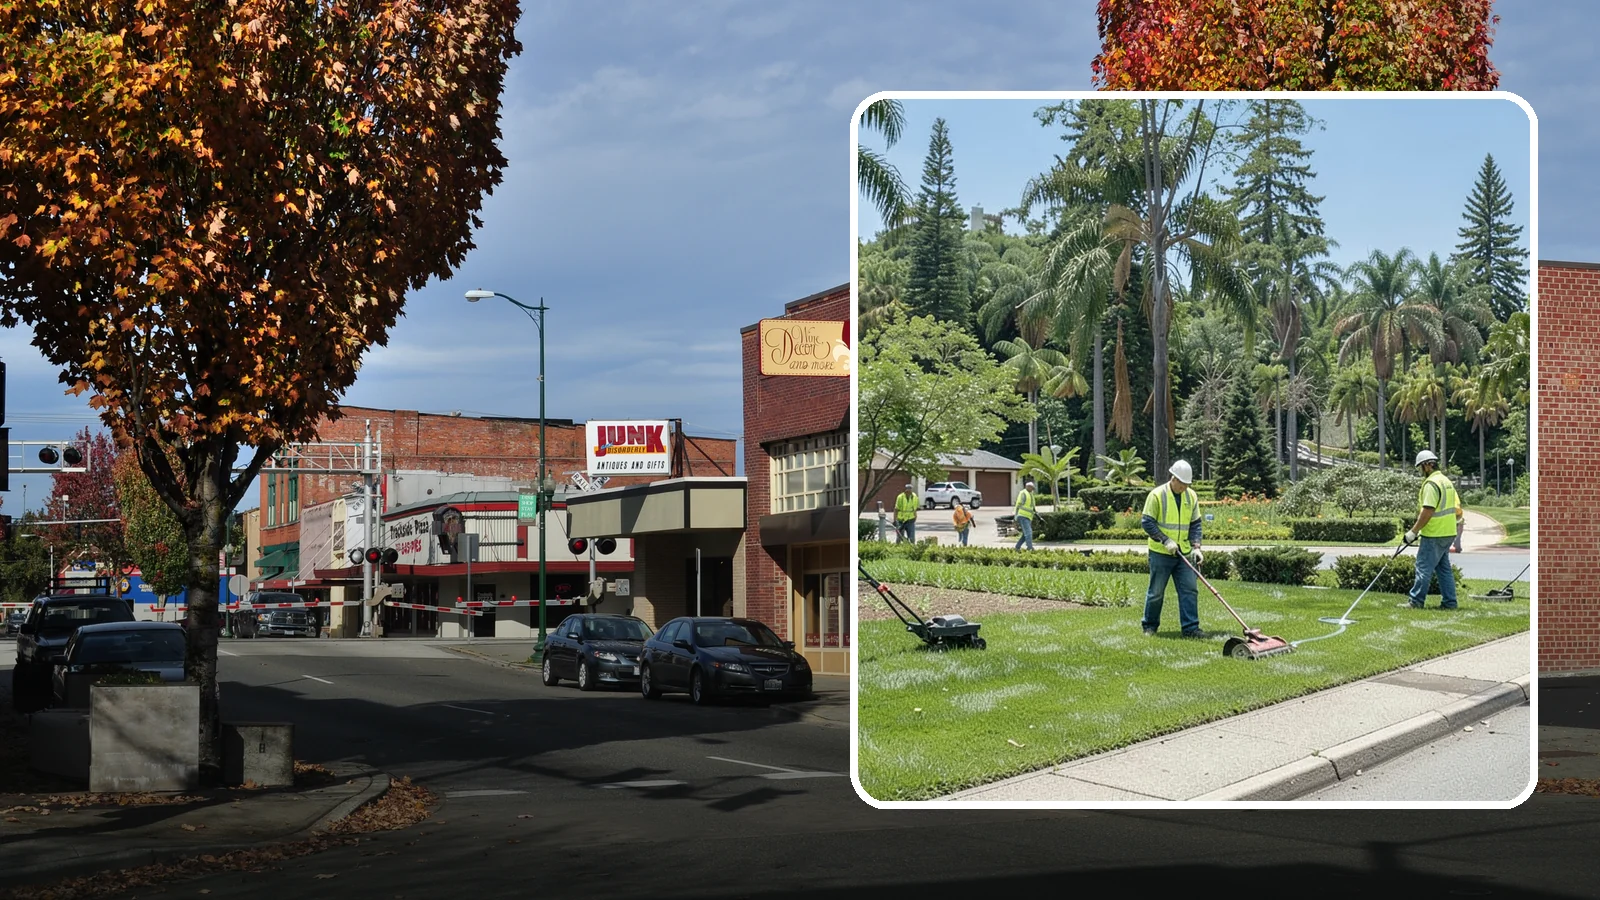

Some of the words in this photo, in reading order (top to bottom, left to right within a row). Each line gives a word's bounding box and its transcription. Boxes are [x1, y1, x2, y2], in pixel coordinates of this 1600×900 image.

[765, 327, 831, 366] Decor
[595, 425, 664, 457] JUNK
[607, 446, 646, 454] DISORDERLY
[597, 461, 628, 470] ANTIQUES
[631, 461, 644, 470] AND
[647, 460, 665, 469] GIFTS
[414, 519, 429, 535] Pizza
